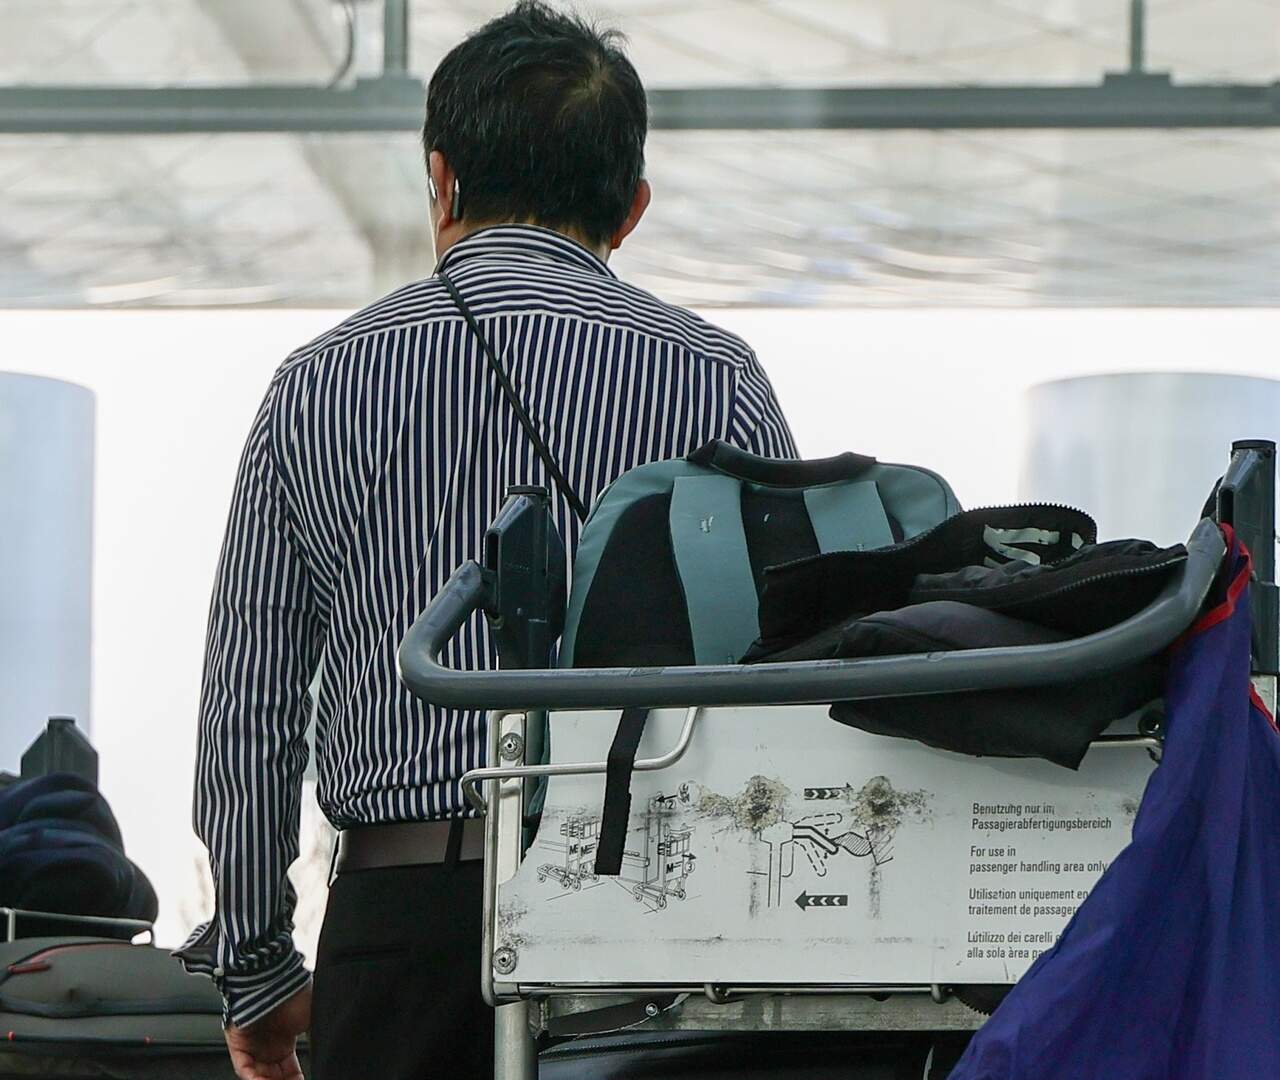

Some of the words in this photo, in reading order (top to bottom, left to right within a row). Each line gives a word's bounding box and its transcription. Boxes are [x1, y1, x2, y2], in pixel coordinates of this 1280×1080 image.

[972, 803, 1022, 816] Benutzung
[1024, 805, 1040, 815] nur
[972, 818, 1112, 832] Passagierabfertigungsbereich
[970, 845, 985, 857] For
[988, 848, 1004, 857] use
[1007, 845, 1016, 857] in
[970, 864, 1018, 875] passenger
[1020, 861, 1060, 875] handling
[1063, 863, 1084, 872] area
[969, 887, 1016, 900] Utilisation
[1019, 888, 1074, 902] uniquement
[968, 904, 1017, 915] traitement
[1019, 903, 1031, 915] de
[1033, 905, 1078, 918] passager
[1007, 931, 1022, 943] dei
[1023, 931, 1053, 943] carelli
[967, 948, 984, 959] alla
[986, 947, 1005, 959] sola
[1008, 947, 1029, 959] àrea
